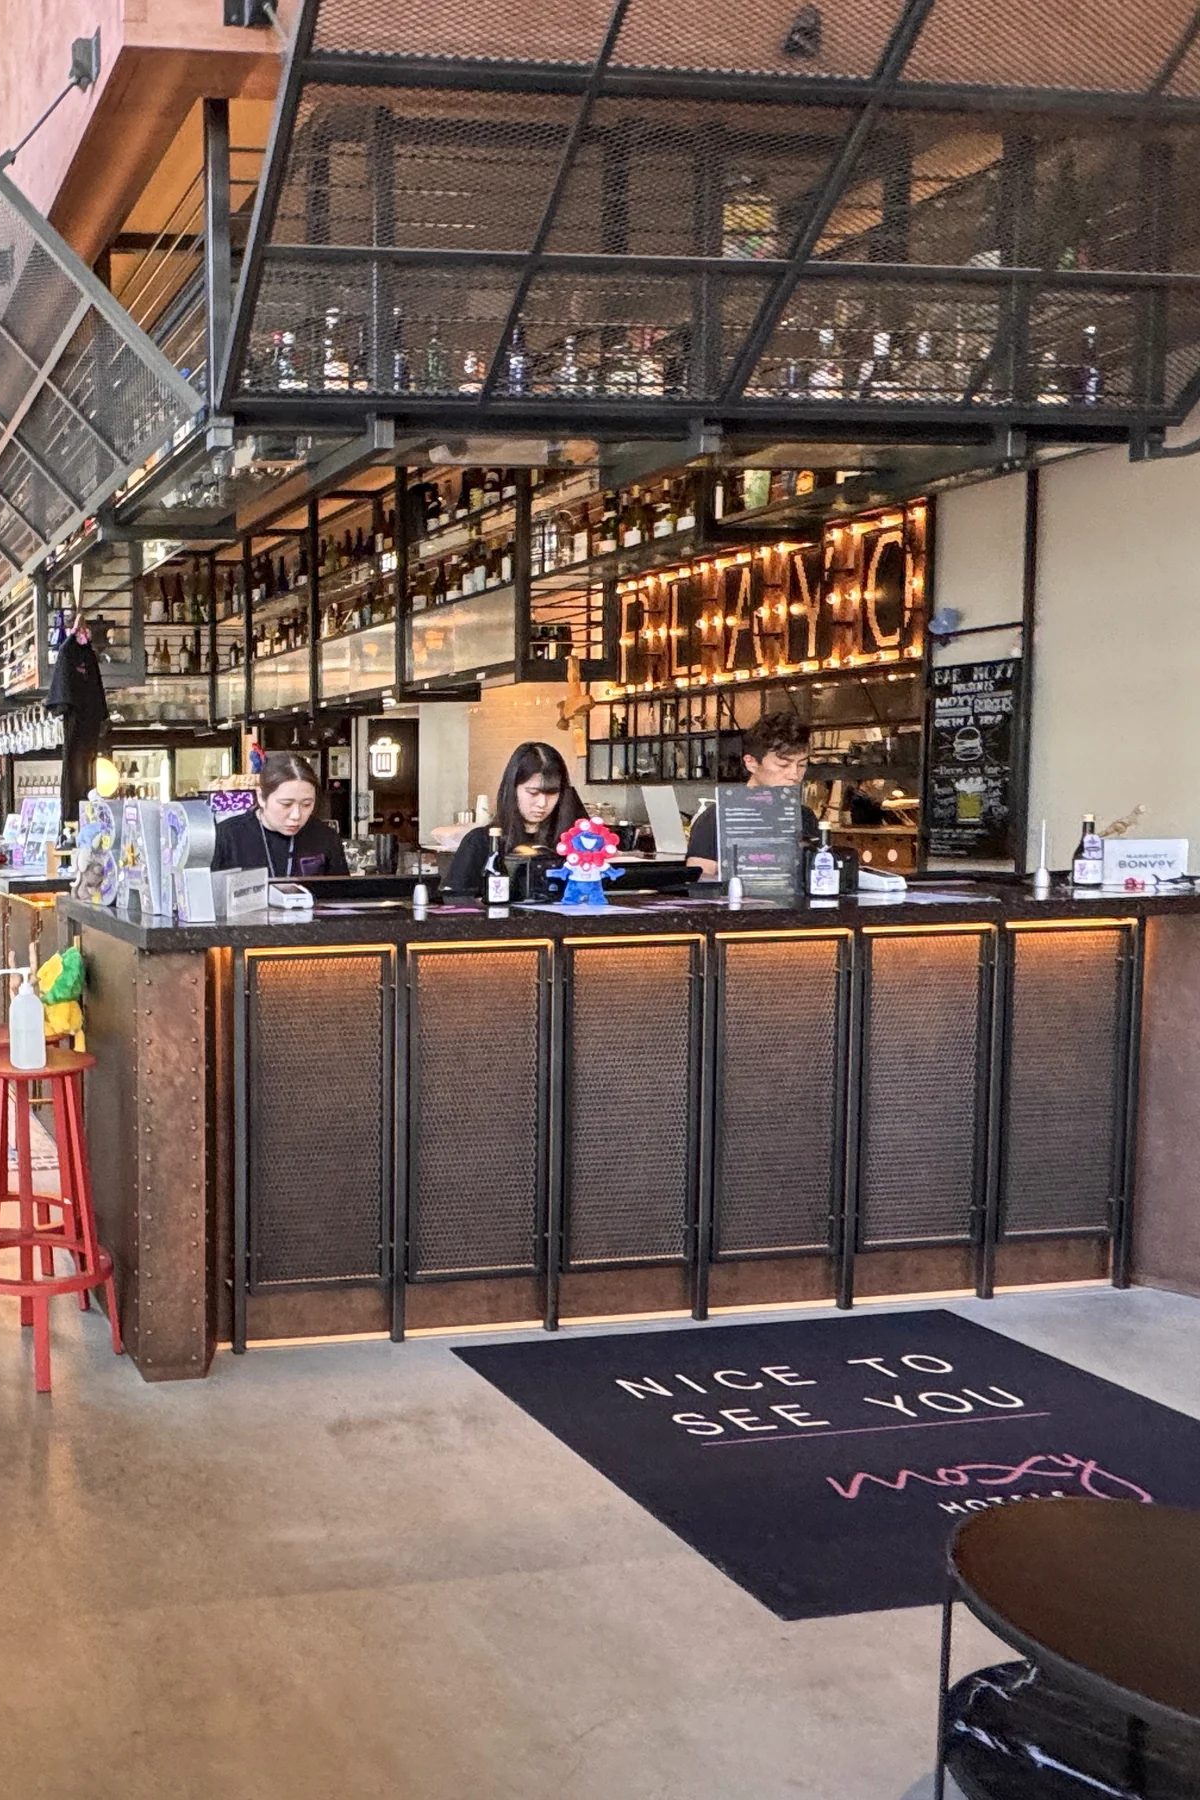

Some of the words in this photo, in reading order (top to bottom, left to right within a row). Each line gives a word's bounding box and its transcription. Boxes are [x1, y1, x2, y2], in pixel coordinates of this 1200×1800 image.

[935, 695, 974, 708] MOXY
[614, 1365, 818, 1400] NICE
[846, 1354, 954, 1378] TO
[671, 1403, 831, 1436] SEE
[862, 1386, 1025, 1418] YOU
